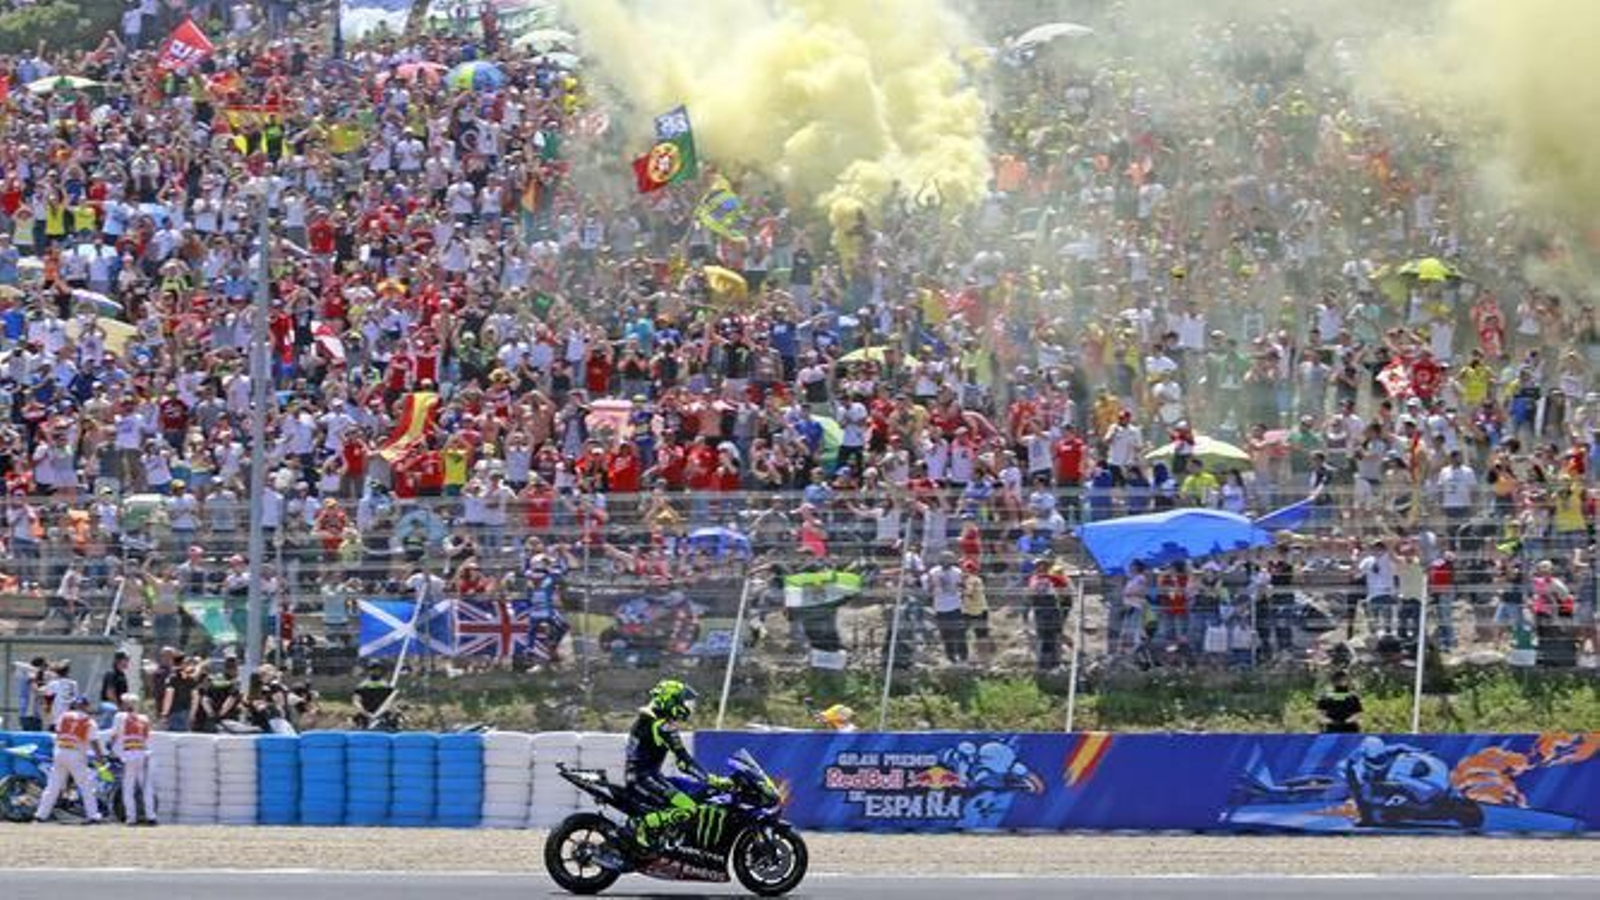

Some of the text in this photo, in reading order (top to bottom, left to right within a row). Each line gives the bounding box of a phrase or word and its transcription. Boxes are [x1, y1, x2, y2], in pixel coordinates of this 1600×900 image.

[838, 753, 937, 766] GRAN PREMIO
[865, 790, 960, 817] ESPAÑA
